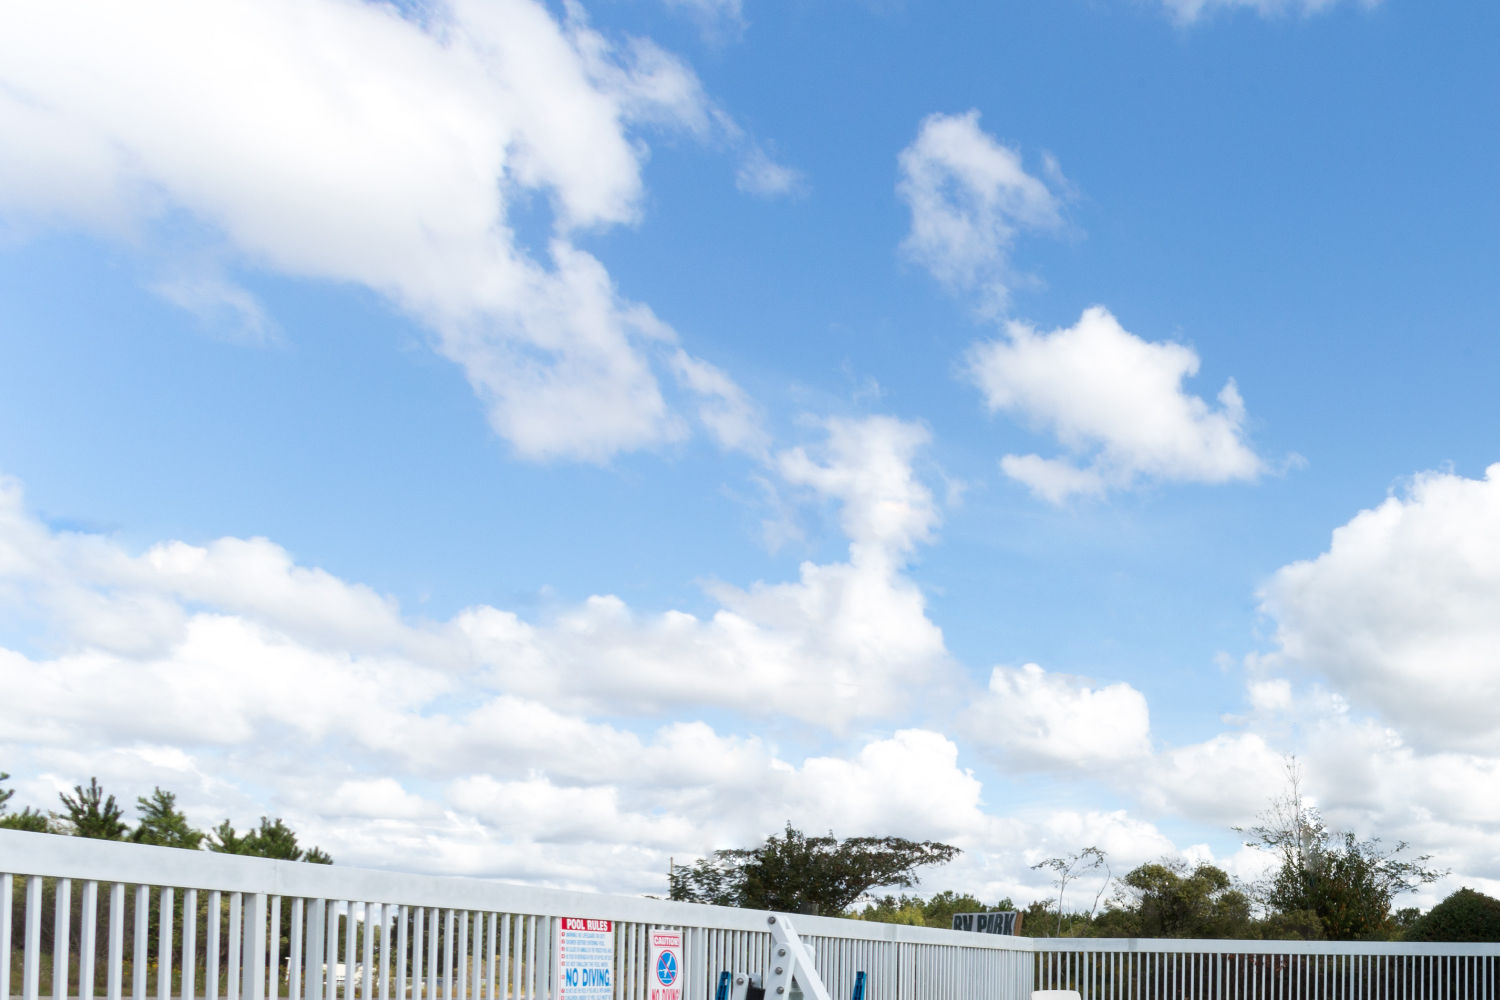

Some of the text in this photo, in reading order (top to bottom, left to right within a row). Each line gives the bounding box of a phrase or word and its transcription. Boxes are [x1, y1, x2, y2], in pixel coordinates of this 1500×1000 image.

[566, 918, 608, 931] POOL RULES
[953, 913, 1015, 935] RV PARK
[566, 968, 578, 986] NO
